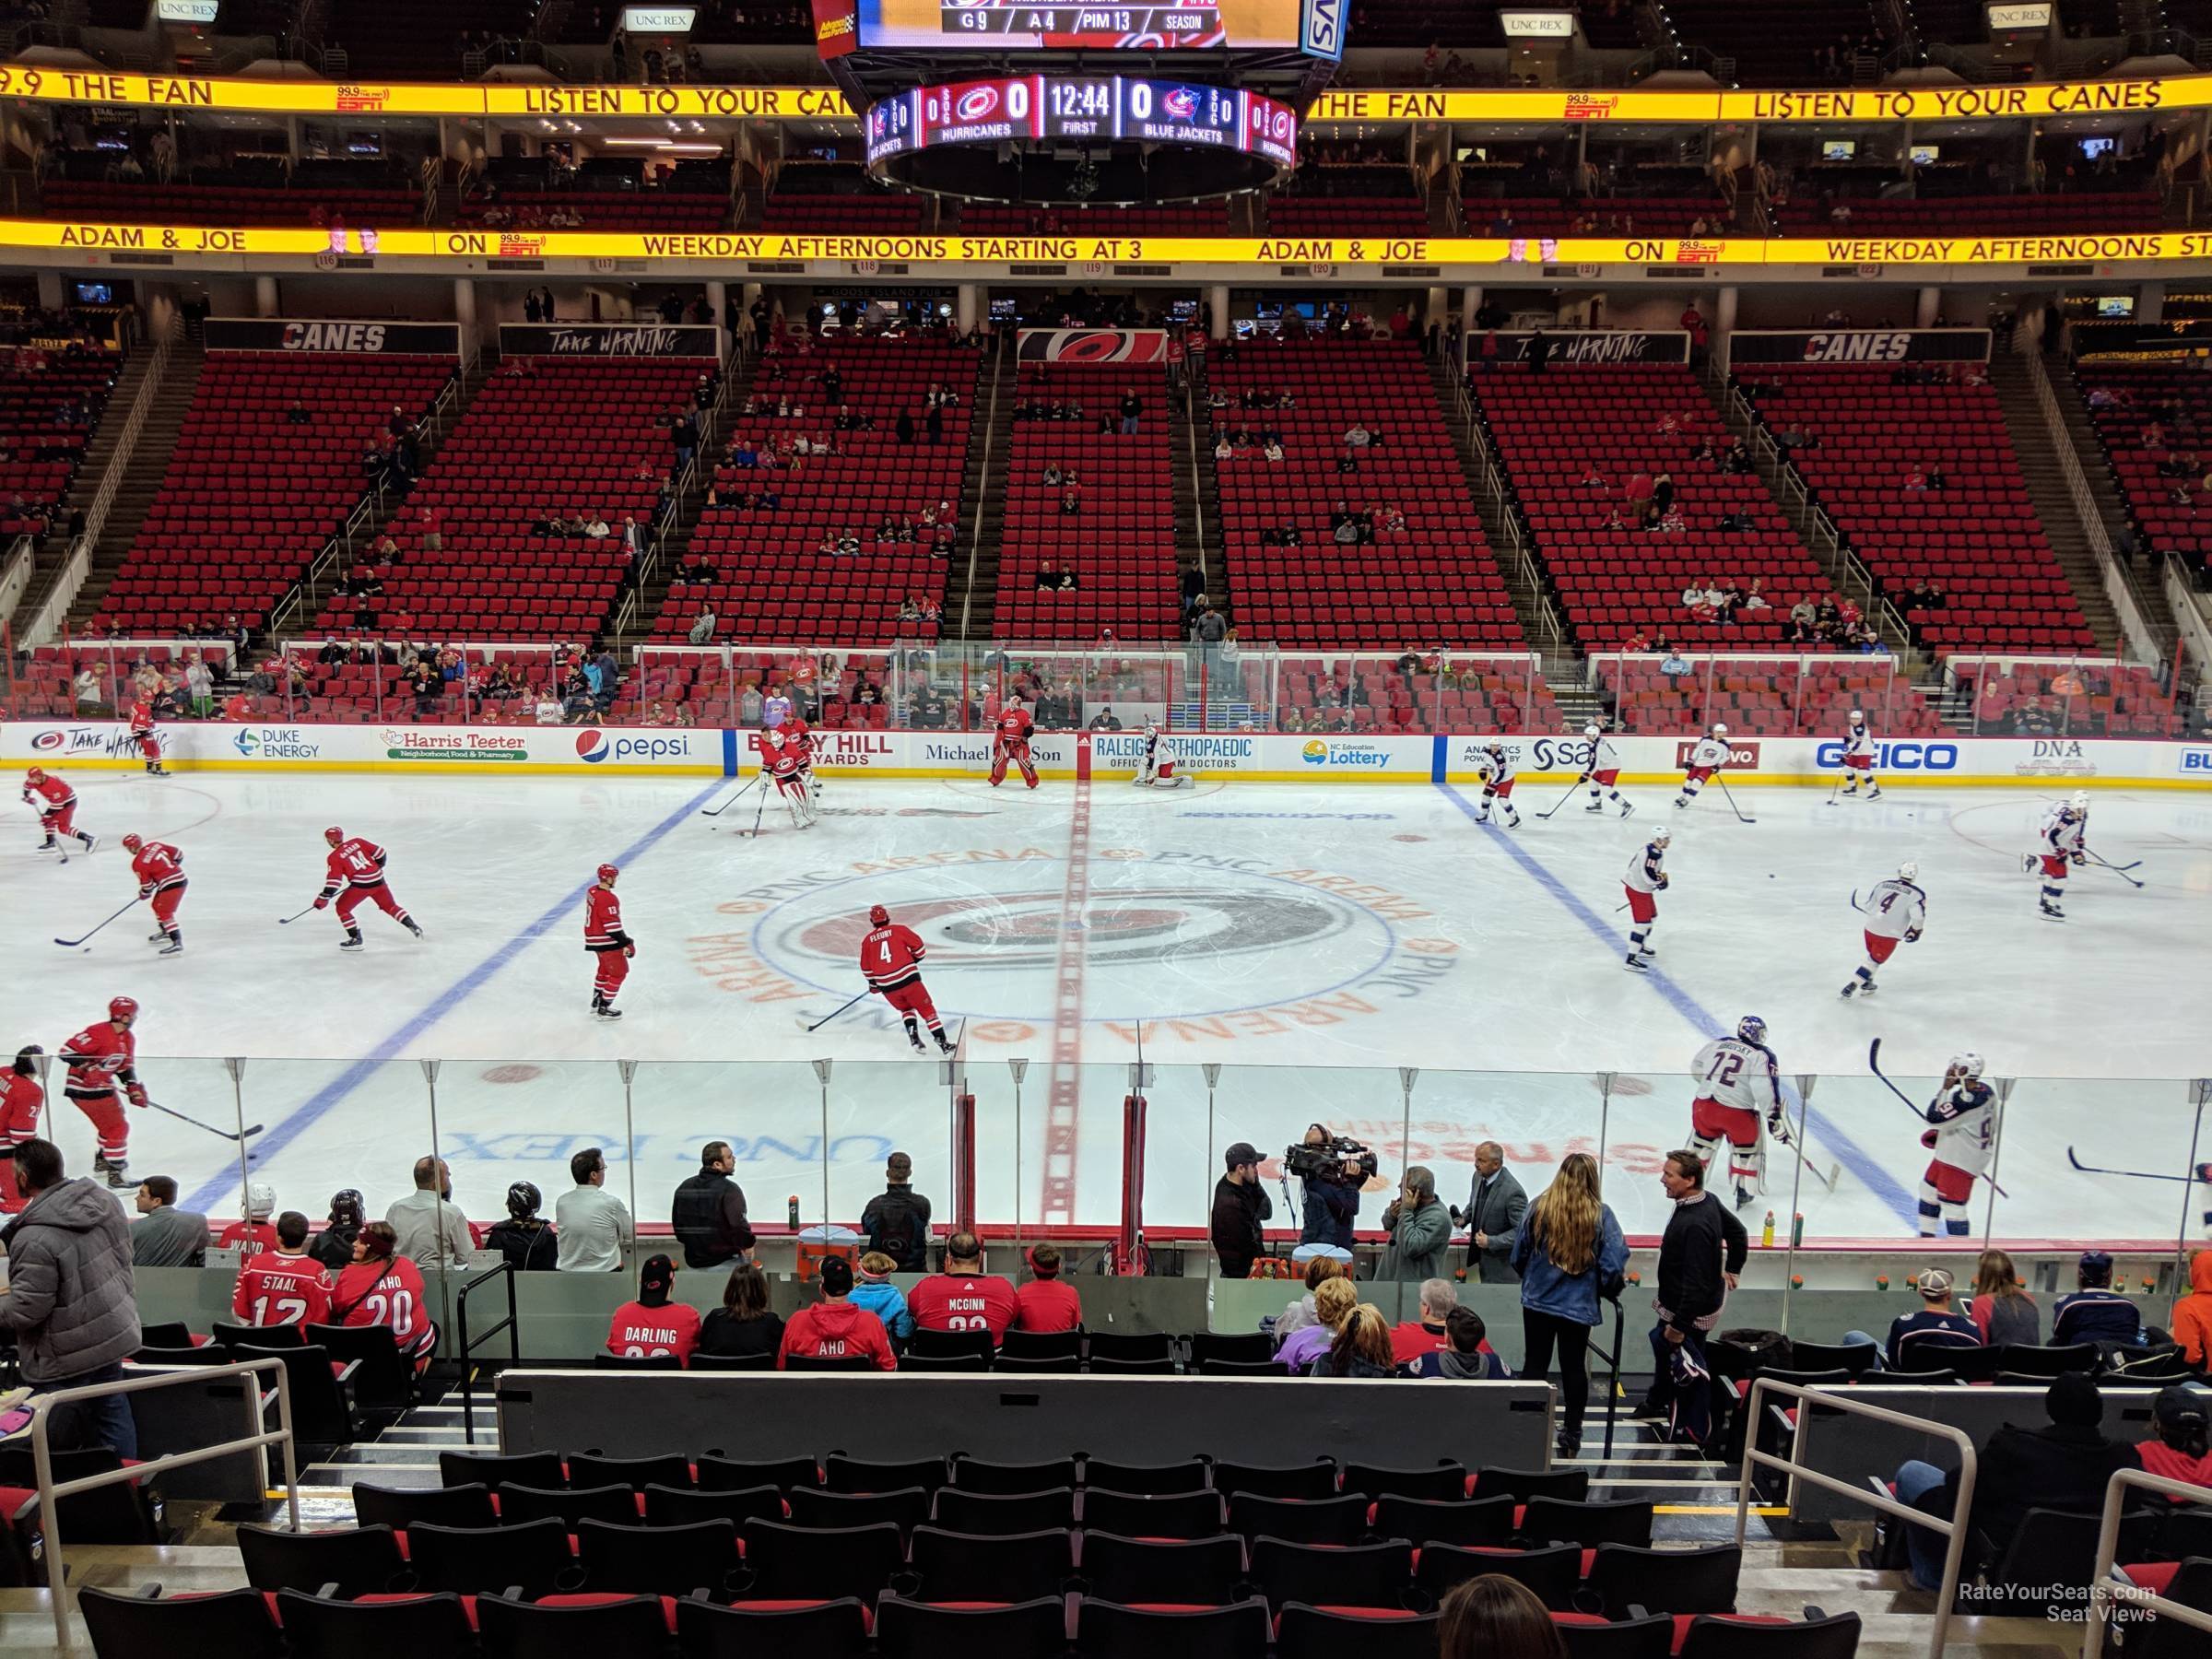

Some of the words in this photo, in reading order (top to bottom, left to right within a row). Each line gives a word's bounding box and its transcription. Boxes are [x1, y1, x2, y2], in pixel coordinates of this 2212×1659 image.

[161, 4, 190, 15] UNC
[192, 5, 218, 16] REX
[1991, 12, 2020, 23] UNC
[2021, 9, 2048, 21] REX
[636, 16, 662, 26] UNC
[665, 16, 687, 26] REX
[962, 15, 973, 27] G
[979, 12, 987, 29] 9
[1030, 14, 1041, 27] A
[1046, 12, 1055, 30] 4
[1083, 13, 1110, 28] PIM
[1115, 12, 1130, 30] 13
[1166, 16, 1202, 29] SEASON
[1511, 20, 1538, 30] UNC
[1540, 20, 1561, 30] REX
[63, 74, 127, 100] THE
[148, 79, 213, 105] FAN
[525, 88, 621, 113] LISTEN
[640, 88, 680, 113] TO
[696, 89, 780, 114] YOUR
[797, 90, 856, 115] CAN
[1007, 83, 1029, 119] 0
[1053, 84, 1110, 116] 12:44
[1132, 83, 1152, 119] 0
[1318, 94, 1369, 117] THE
[1388, 94, 1446, 117] FAN
[1754, 92, 1854, 118] LISTEN
[1874, 92, 1915, 117] TO
[1936, 89, 2027, 115] YOUR
[2047, 82, 2162, 112] CANES
[900, 105, 908, 127] 0
[928, 99, 938, 121] 0
[1221, 100, 1231, 122] 0
[1253, 107, 1262, 130] 0
[942, 124, 1012, 141] HURRICANES
[1063, 121, 1097, 135] FIRST
[1145, 124, 1175, 138] BLUE
[1177, 127, 1222, 143] JACKETS
[60, 226, 145, 248] ADAM
[162, 229, 180, 249] &
[195, 229, 246, 250] JOE
[448, 234, 487, 253] ON
[643, 236, 763, 256] WEEKDAY
[780, 237, 947, 258] AFTERNOONS
[962, 239, 1077, 259] STARTING
[1092, 240, 1122, 259] AT
[1129, 241, 1143, 259] 3
[1257, 241, 1333, 260] ADAM
[1347, 241, 1365, 260] &
[1381, 241, 1427, 260] JOE
[1625, 241, 1664, 260] ON
[1827, 241, 1955, 261] WEEKDAY
[1969, 236, 2162, 260] AFTERNOONS
[319, 255, 335, 266] 116
[599, 259, 613, 269] 117
[860, 261, 876, 271] 118
[1086, 263, 1101, 274] 119
[1312, 264, 1329, 274] 120
[1580, 264, 1595, 274] 121
[1860, 264, 1876, 274] 122
[831, 287, 871, 296] GOOSE
[875, 288, 915, 297] ISLAND
[921, 288, 941, 297] PUB
[282, 323, 385, 352] CANES
[549, 329, 592, 353] TAKE
[599, 326, 681, 356] WARNING
[1804, 333, 1911, 360] CANES
[1517, 337, 1560, 360] TE
[1566, 333, 1652, 362] WARNING
[67, 727, 103, 749] TAKE
[105, 726, 175, 759] WARNG
[263, 730, 300, 743] DUKE
[404, 733, 462, 748] Harris
[466, 734, 525, 748] Teeter
[837, 735, 894, 754] HILL
[264, 745, 319, 759] ENERGY
[400, 750, 450, 759] Neighborhood
[477, 751, 515, 759] Pharmacy
[616, 735, 689, 760] pepsi
[924, 743, 990, 761] Michael
[1030, 746, 1062, 762] Son
[1097, 737, 1145, 757] RALEIG
[1169, 738, 1253, 758] RTHOPAEDIC
[1330, 743, 1340, 751] NC
[1342, 743, 1375, 751] Education
[1465, 746, 1521, 754] ANAICS
[1557, 742, 1591, 765] sa
[2033, 740, 2083, 758] DNA
[813, 754, 870, 765] YARDS
[1110, 759, 1141, 768] OFFIC
[1189, 759, 1237, 768] DOCTORS
[1330, 749, 1391, 768] Lottery
[1509, 755, 1521, 763] BY
[349, 850, 373, 870] 44
[739, 870, 852, 900] PNC
[849, 847, 1055, 876] ARENA
[1150, 850, 1272, 873] PNC
[1270, 868, 1436, 921] ARENA
[607, 906, 618, 915] 13
[1880, 891, 1900, 914] 4
[869, 928, 893, 943] FLEURY
[880, 940, 892, 964] 4
[686, 930, 820, 1005] ARENA
[1357, 954, 1458, 999] PNC
[1103, 991, 1382, 1044] ARENA
[1705, 1051, 1745, 1088] 72
[1938, 1101, 1959, 1119] 91
[441, 1132, 660, 1161] REX
[675, 1134, 896, 1162] UNC
[230, 1240, 265, 1254] WARD
[262, 1276, 297, 1292] STAAL
[379, 1276, 402, 1290] AHO
[367, 1290, 413, 1336] 20
[948, 1298, 985, 1311] MCGINN
[625, 1326, 677, 1344] DARLING
[818, 1340, 845, 1356] AHO
